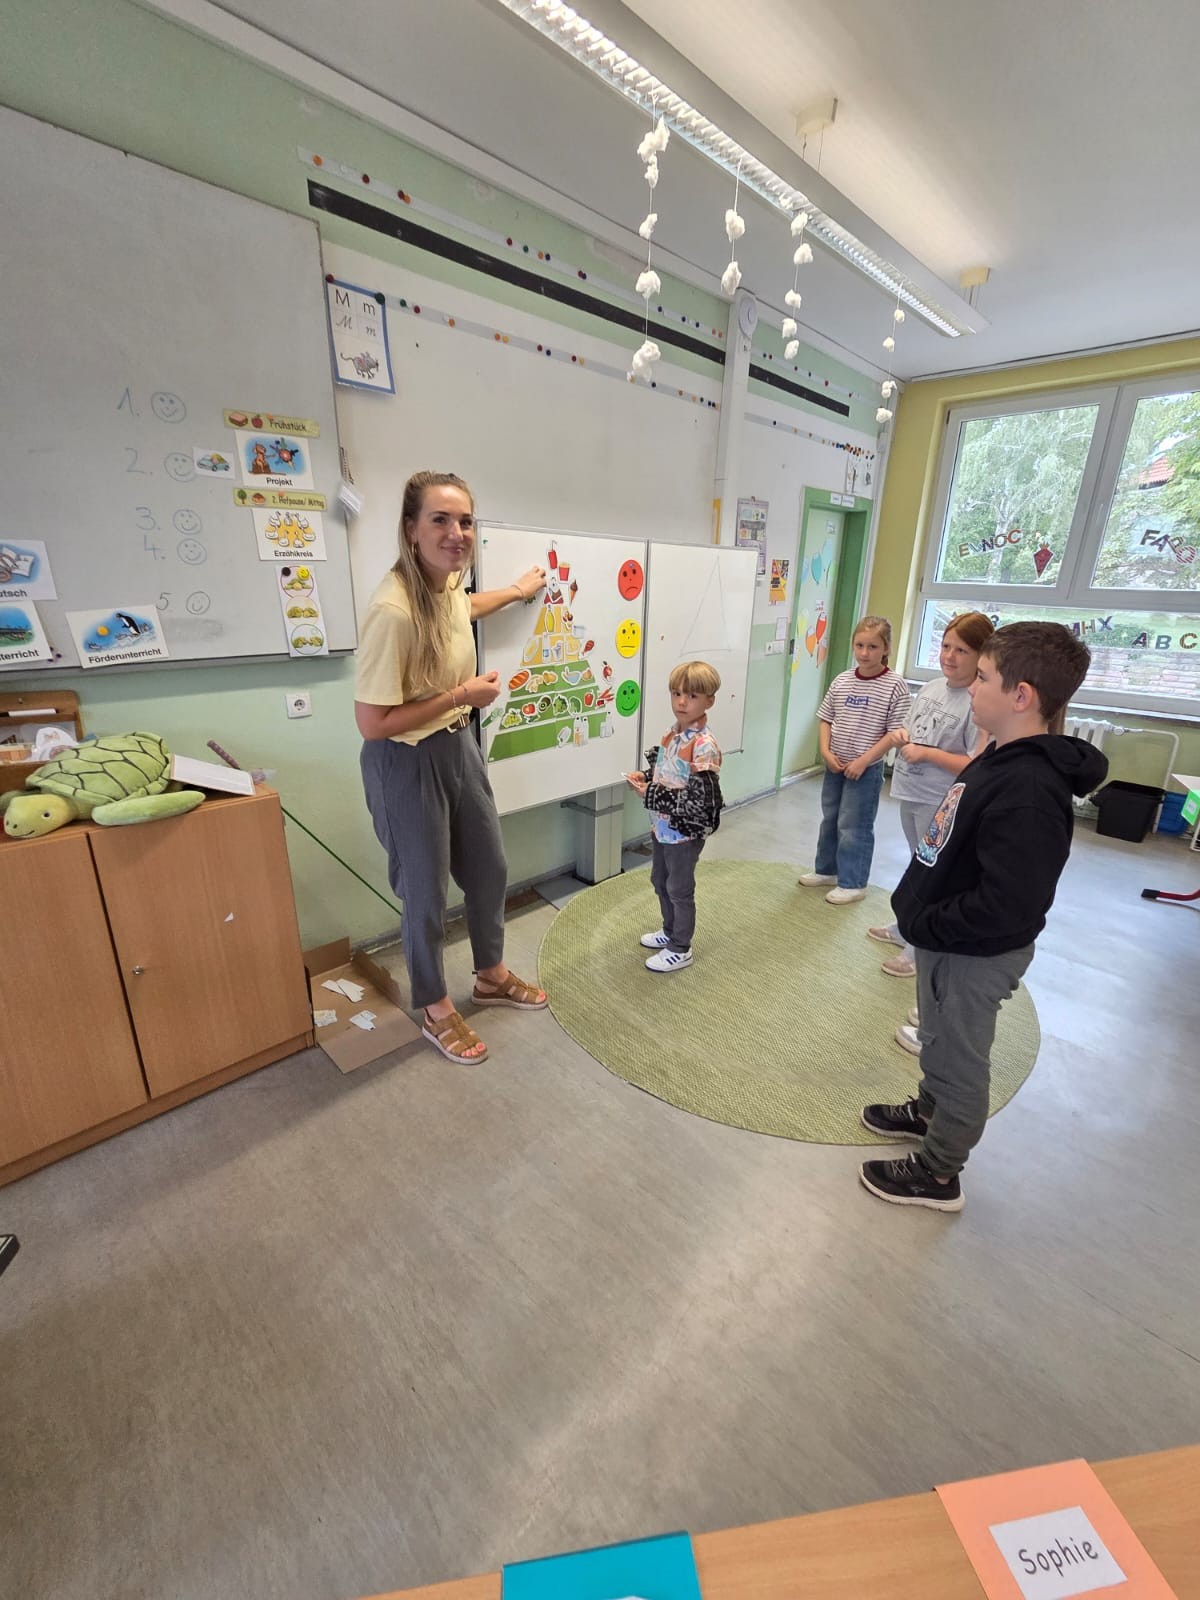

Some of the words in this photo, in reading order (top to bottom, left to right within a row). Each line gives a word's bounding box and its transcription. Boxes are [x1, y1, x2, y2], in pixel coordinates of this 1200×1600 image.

[335, 289, 351, 308] M
[364, 302, 376, 316] m
[265, 477, 294, 487] Projekt
[273, 550, 314, 558] Erzählkreis
[88, 648, 162, 664] Förderunterricht
[1018, 1536, 1099, 1578] Sophie
